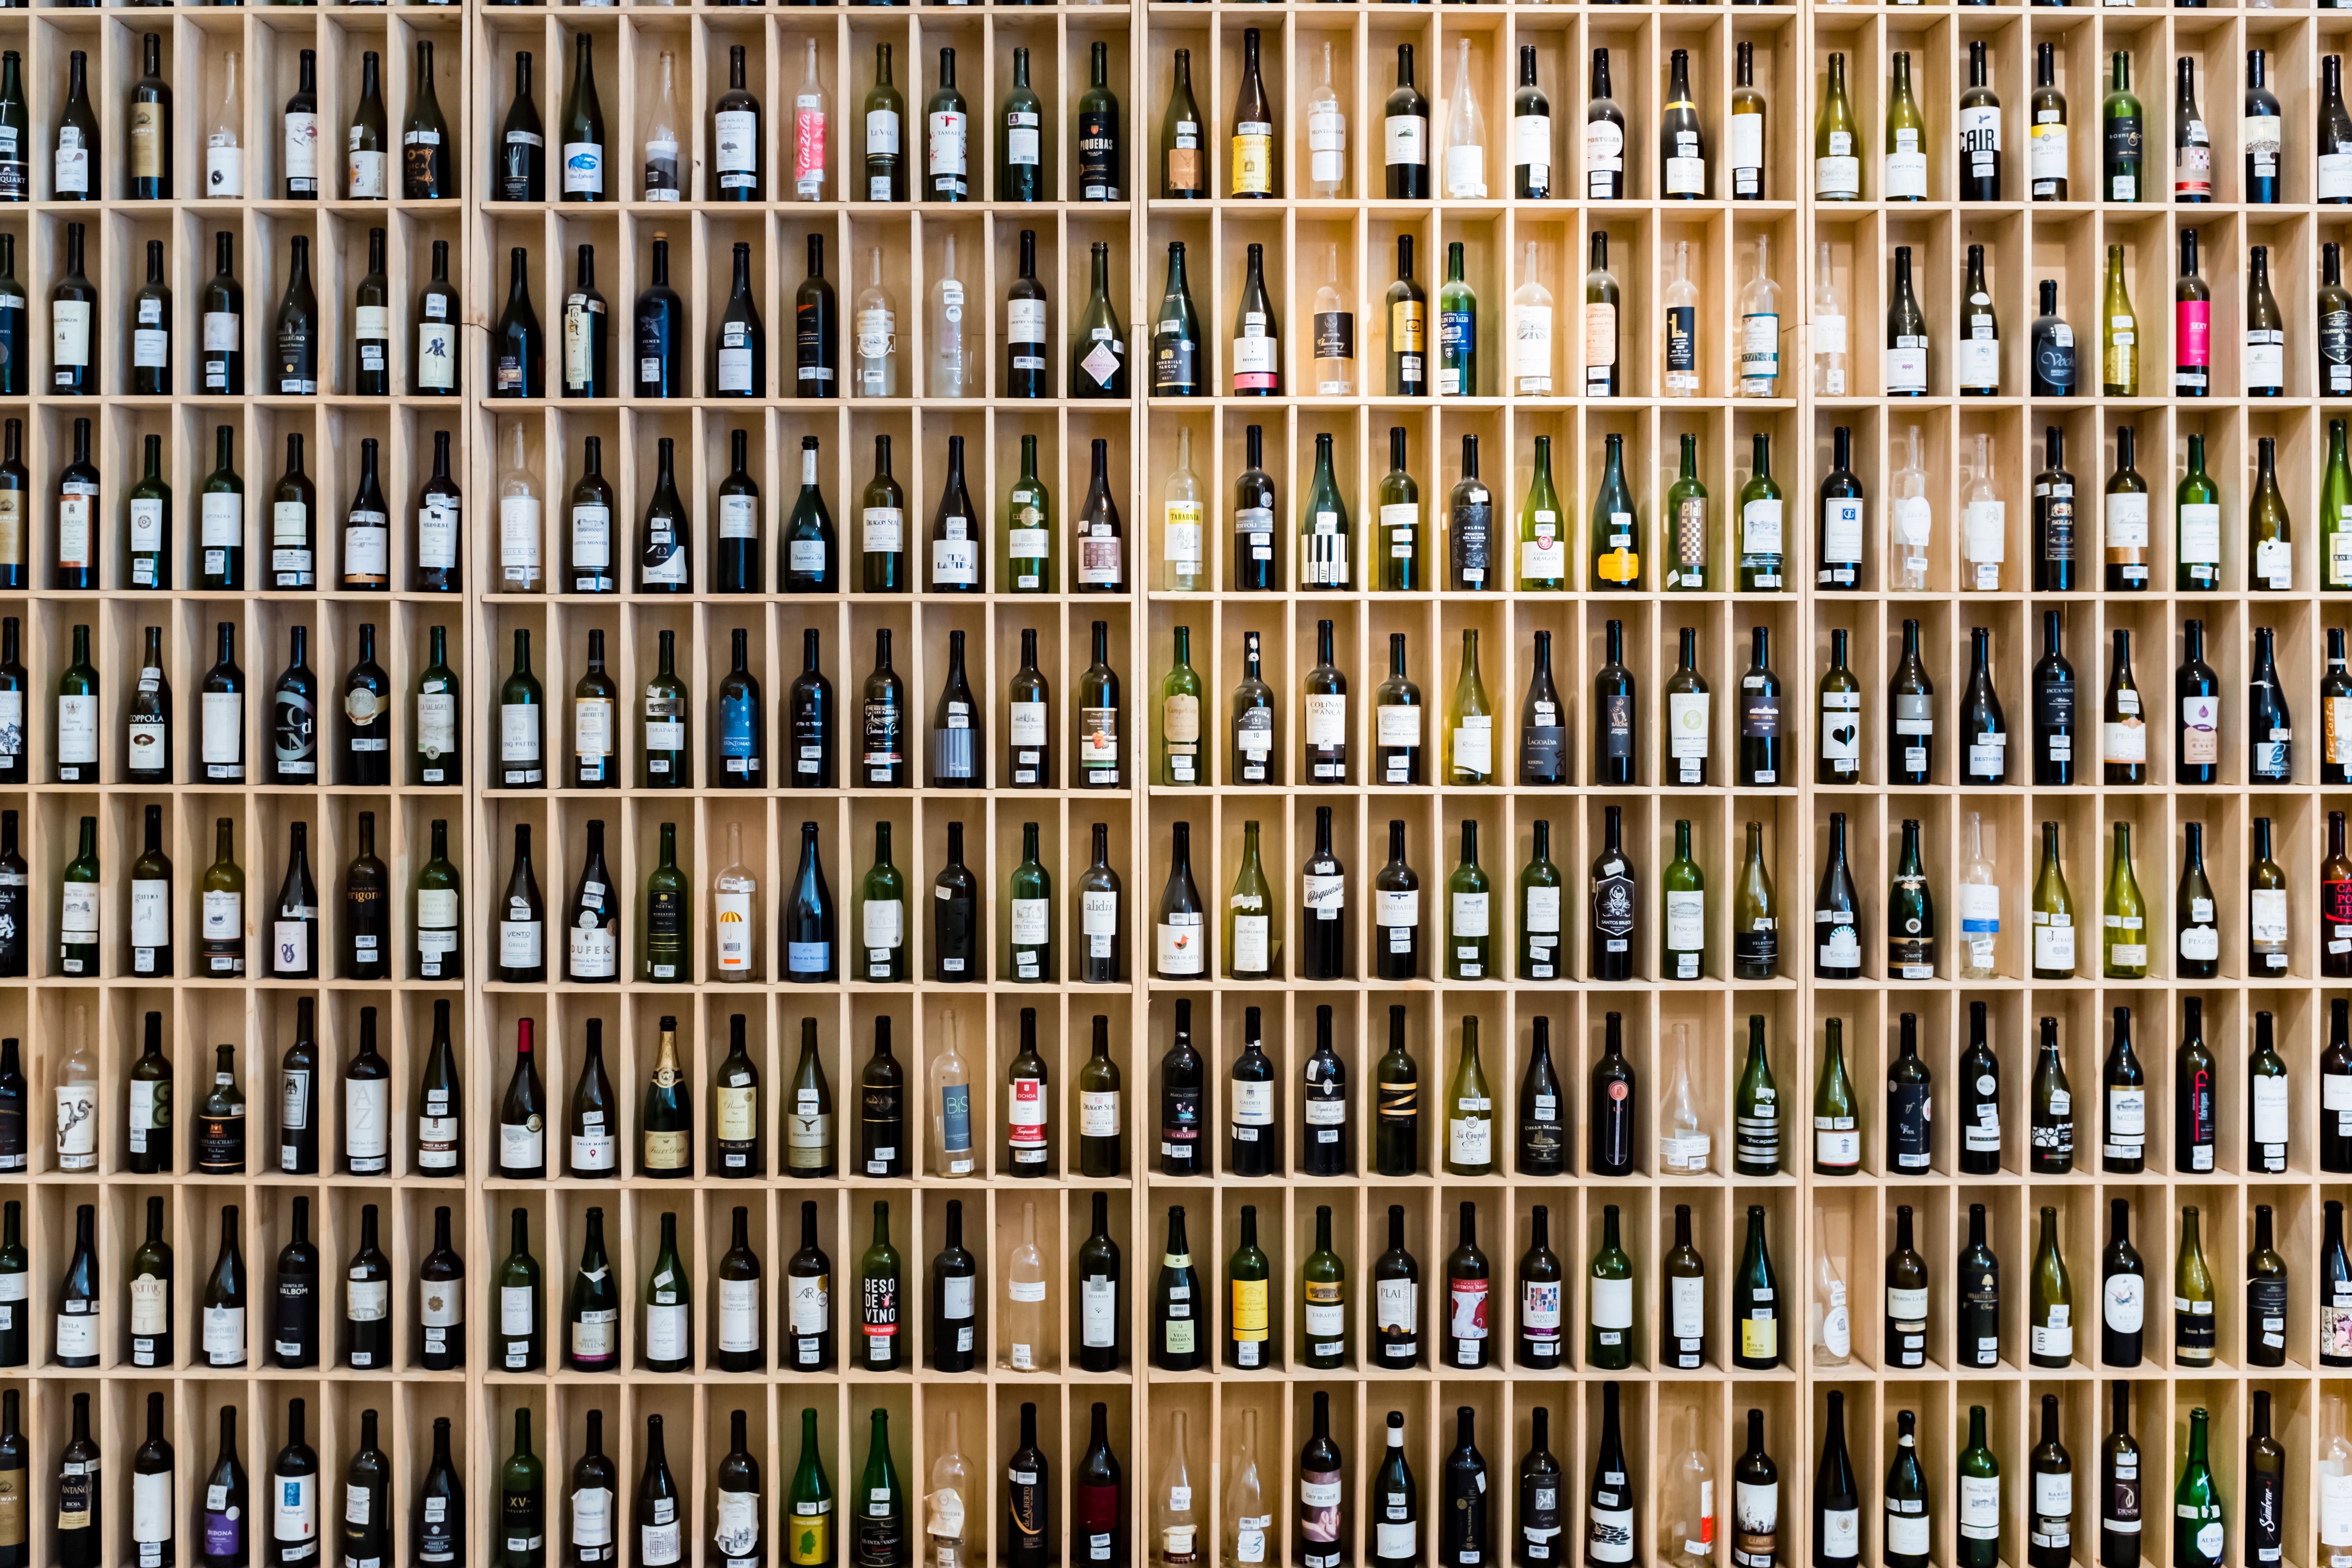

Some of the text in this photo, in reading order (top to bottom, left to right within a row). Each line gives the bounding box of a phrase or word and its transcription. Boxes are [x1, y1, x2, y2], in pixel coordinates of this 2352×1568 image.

[800, 113, 811, 167] Gazela
[1080, 138, 1113, 151] PIQUERAS
[1960, 129, 1994, 152] CAIR
[1528, 737, 1556, 745] LAGOALVA
[135, 893, 158, 903] gamo
[1086, 901, 1112, 911] alidis
[571, 945, 610, 954] DUFEK
[723, 943, 740, 951] UMBRELLA
[1016, 1126, 1037, 1135] Tempranillo
[865, 1278, 895, 1293] BESO
[1381, 1288, 1400, 1298] PLAI
[866, 1293, 878, 1308] DE
[866, 1308, 895, 1323] VINO
[62, 1485, 87, 1494] ANTAÑO
[510, 1497, 526, 1507] XV
[1023, 1518, 1029, 1527] de
